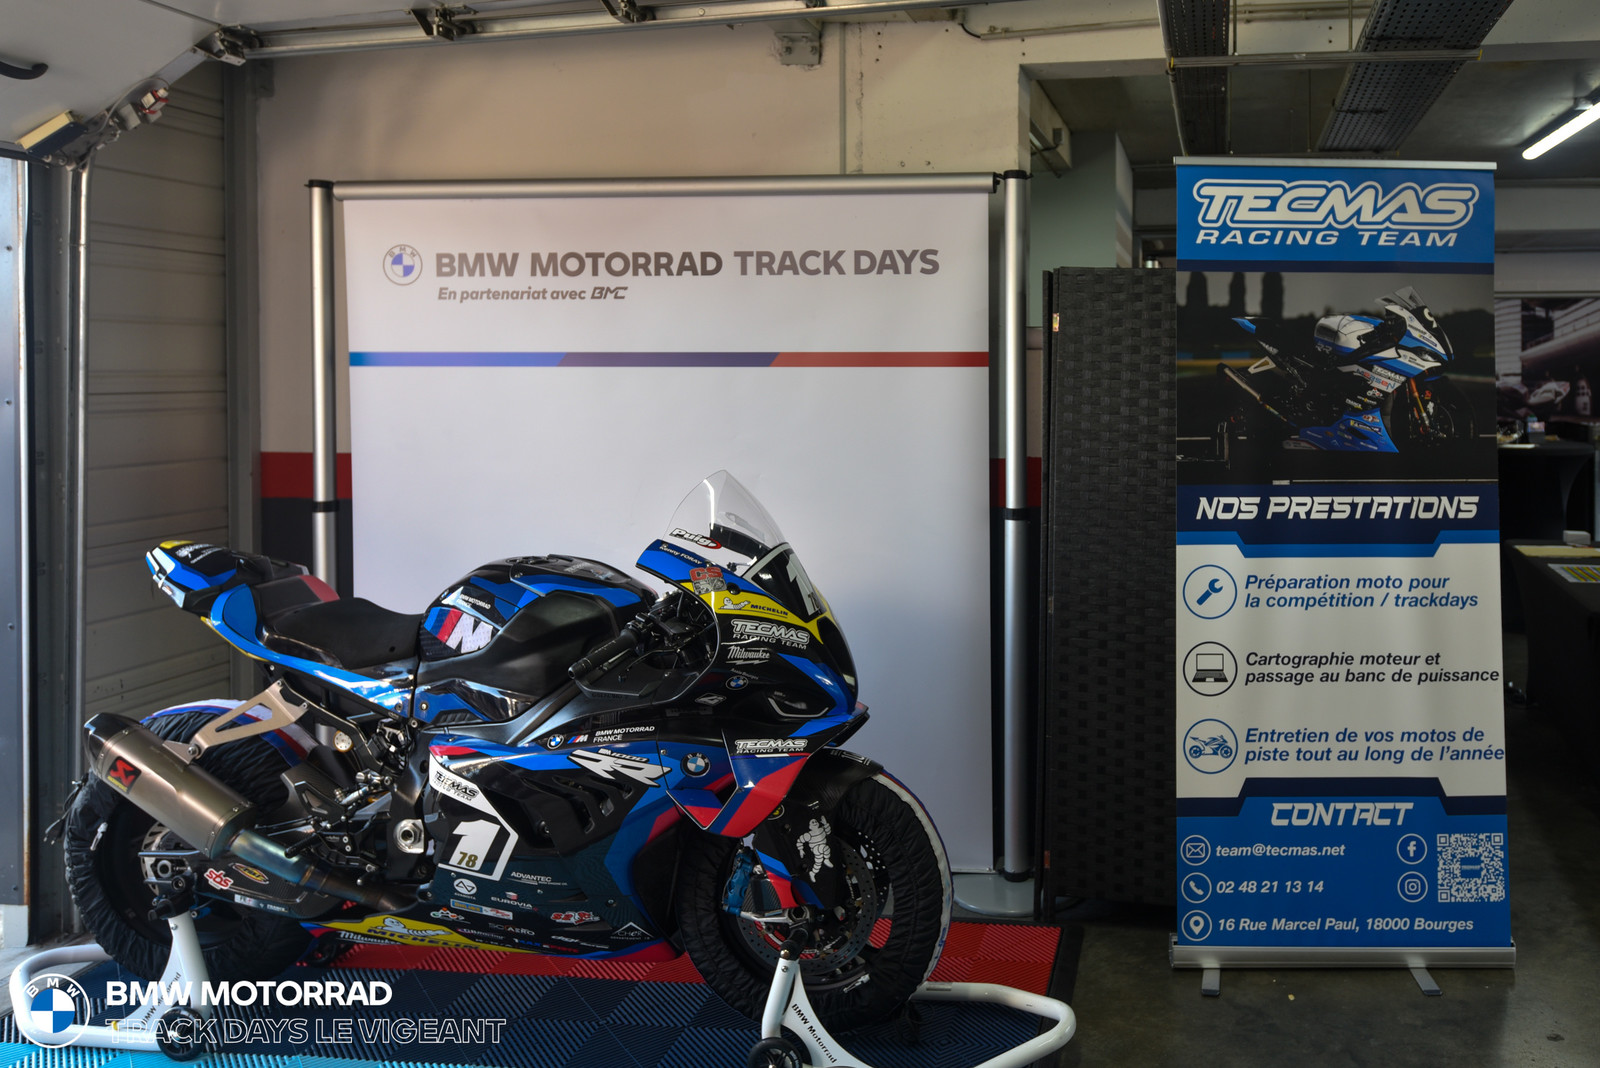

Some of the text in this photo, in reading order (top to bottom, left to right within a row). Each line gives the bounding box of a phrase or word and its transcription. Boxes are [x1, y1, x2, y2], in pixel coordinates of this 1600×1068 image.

[1193, 178, 1480, 230] TECMAS
[1196, 229, 1458, 247] RACING TEAM
[436, 248, 940, 277] BMW MOTORRAD TRACK DAYS
[437, 285, 629, 304] En partenariat avec BMC
[1195, 496, 1480, 520] NOS PRESTATIONS
[1245, 574, 1450, 592] Préparation moto pour
[750, 604, 788, 616] MICHELIN
[1245, 592, 1479, 610] la compétition / trackdays
[731, 619, 810, 644] TECMAS
[727, 645, 770, 660] Milwaukee
[780, 640, 807, 650] TEAM
[1245, 651, 1441, 669] Cartographie moteur et
[1245, 668, 1500, 686] passage au banc de puissance
[592, 734, 623, 743] FRANCE
[612, 725, 656, 735] MOTORRAD
[1245, 726, 1485, 743] Entretien de vos motos de
[734, 738, 809, 750] TECMAS
[1245, 744, 1505, 765] piste tout au long de l’année
[1271, 802, 1414, 826] CONTACT
[448, 819, 501, 871] 1
[1215, 844, 1346, 857] team@tecmas.net
[456, 851, 478, 868] 78
[510, 871, 552, 882] ADVANTEC
[1216, 880, 1324, 894] 02 48 21 13 14
[490, 896, 533, 909] EUROVIA
[1218, 917, 1474, 934] 16 Rue Marcel Paul, 18000 Bourges
[791, 1003, 838, 1065] BMW Motorrad
